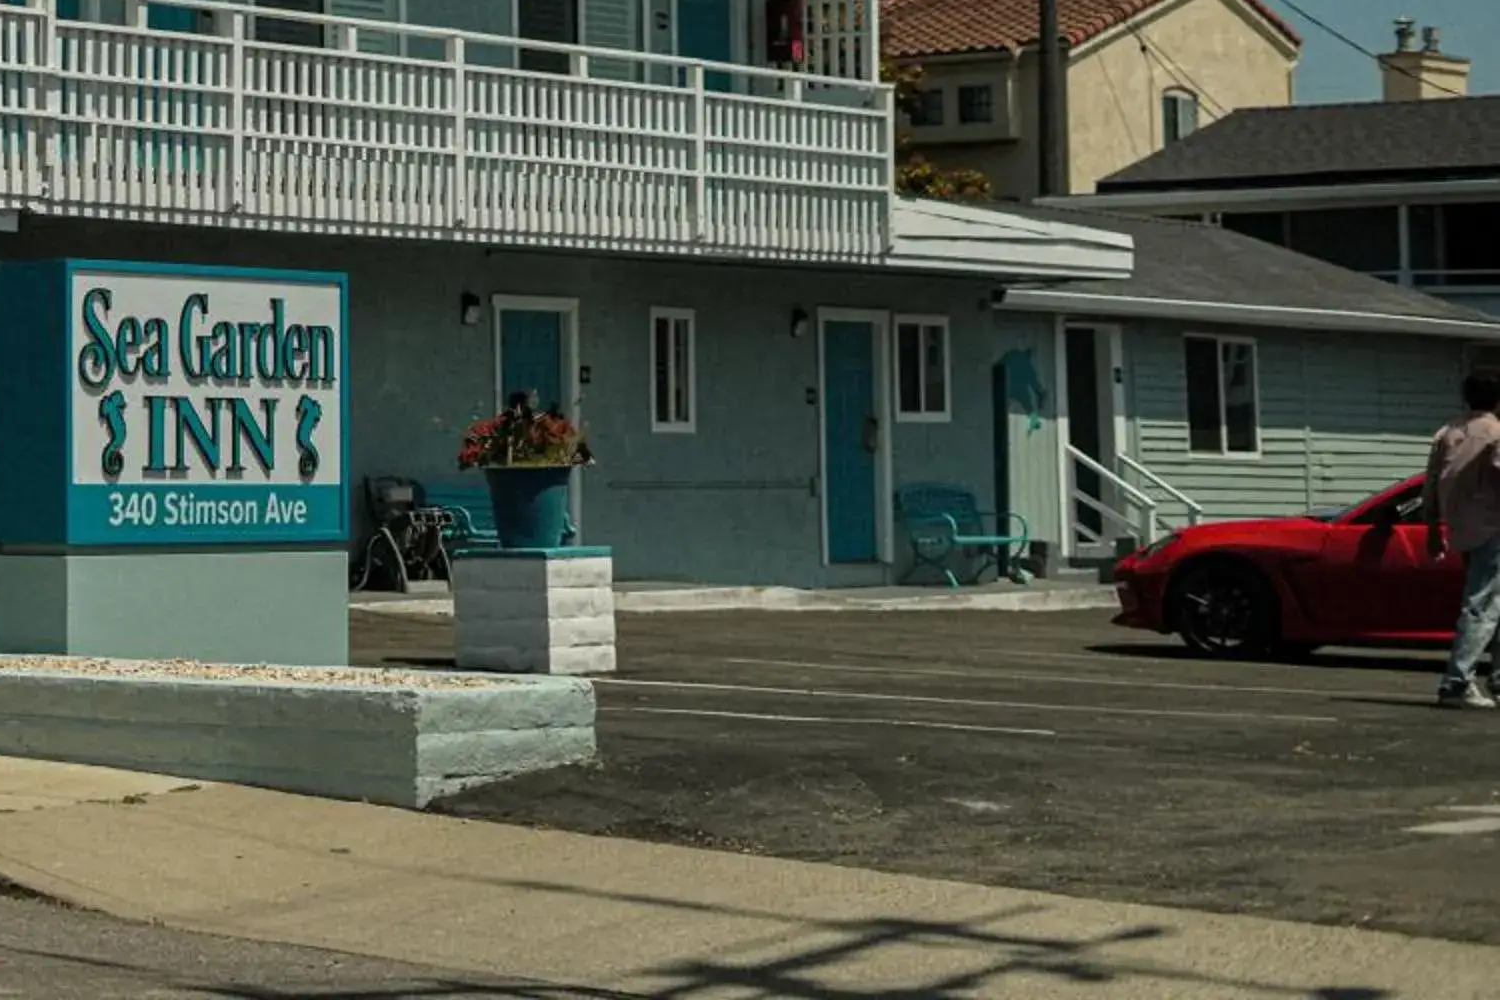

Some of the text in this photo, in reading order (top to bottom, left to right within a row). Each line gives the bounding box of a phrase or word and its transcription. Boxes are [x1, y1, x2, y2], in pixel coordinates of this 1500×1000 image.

[78, 287, 337, 390] Sea Garden
[142, 395, 282, 479] INN
[109, 492, 307, 526] 340 Stimson Ave
